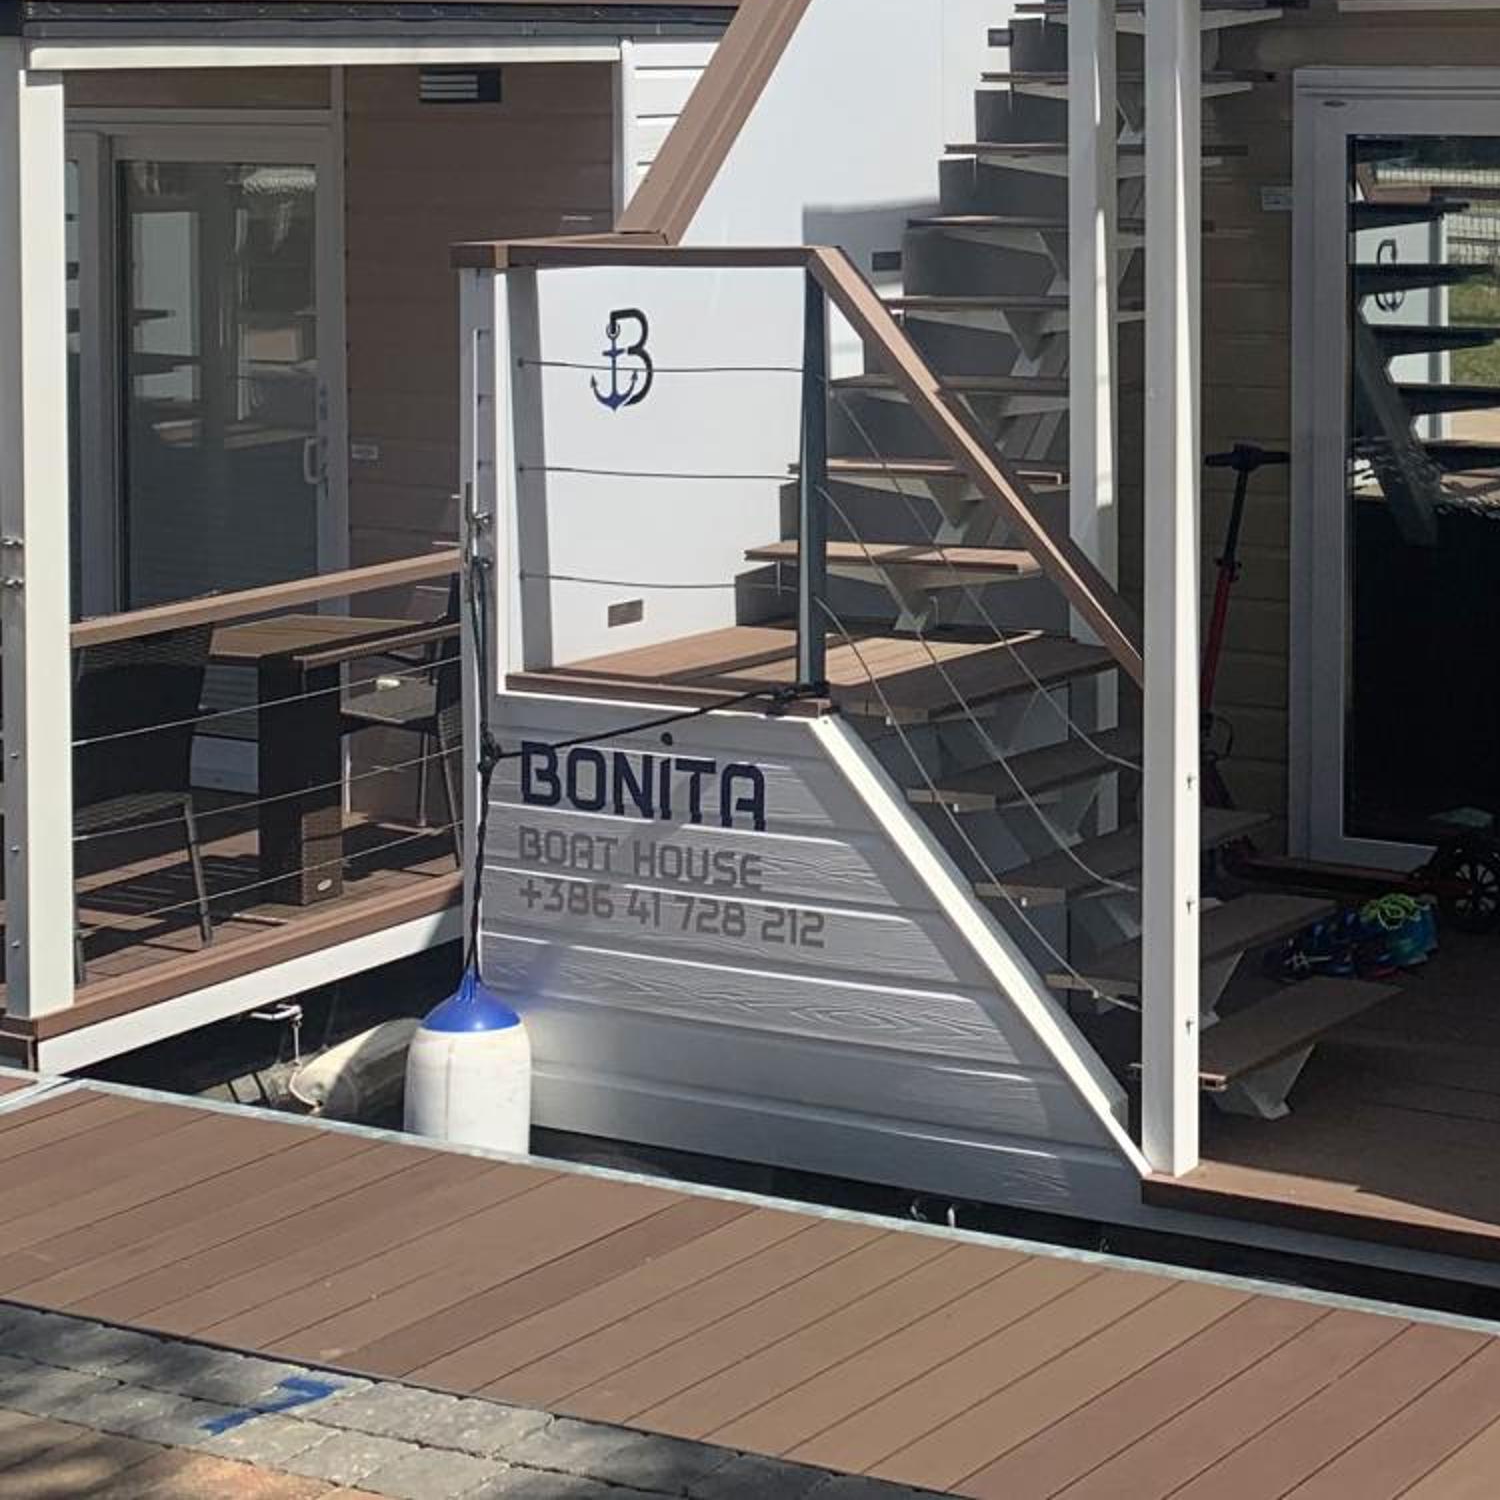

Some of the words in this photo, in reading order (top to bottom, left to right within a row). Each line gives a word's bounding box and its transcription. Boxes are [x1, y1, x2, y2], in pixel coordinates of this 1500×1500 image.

[519, 825, 618, 871] BOAT
[634, 839, 762, 891] HOUSE
[520, 877, 615, 920] +386
[627, 890, 661, 927] 41
[670, 898, 746, 938] 728
[761, 906, 825, 949] 212
